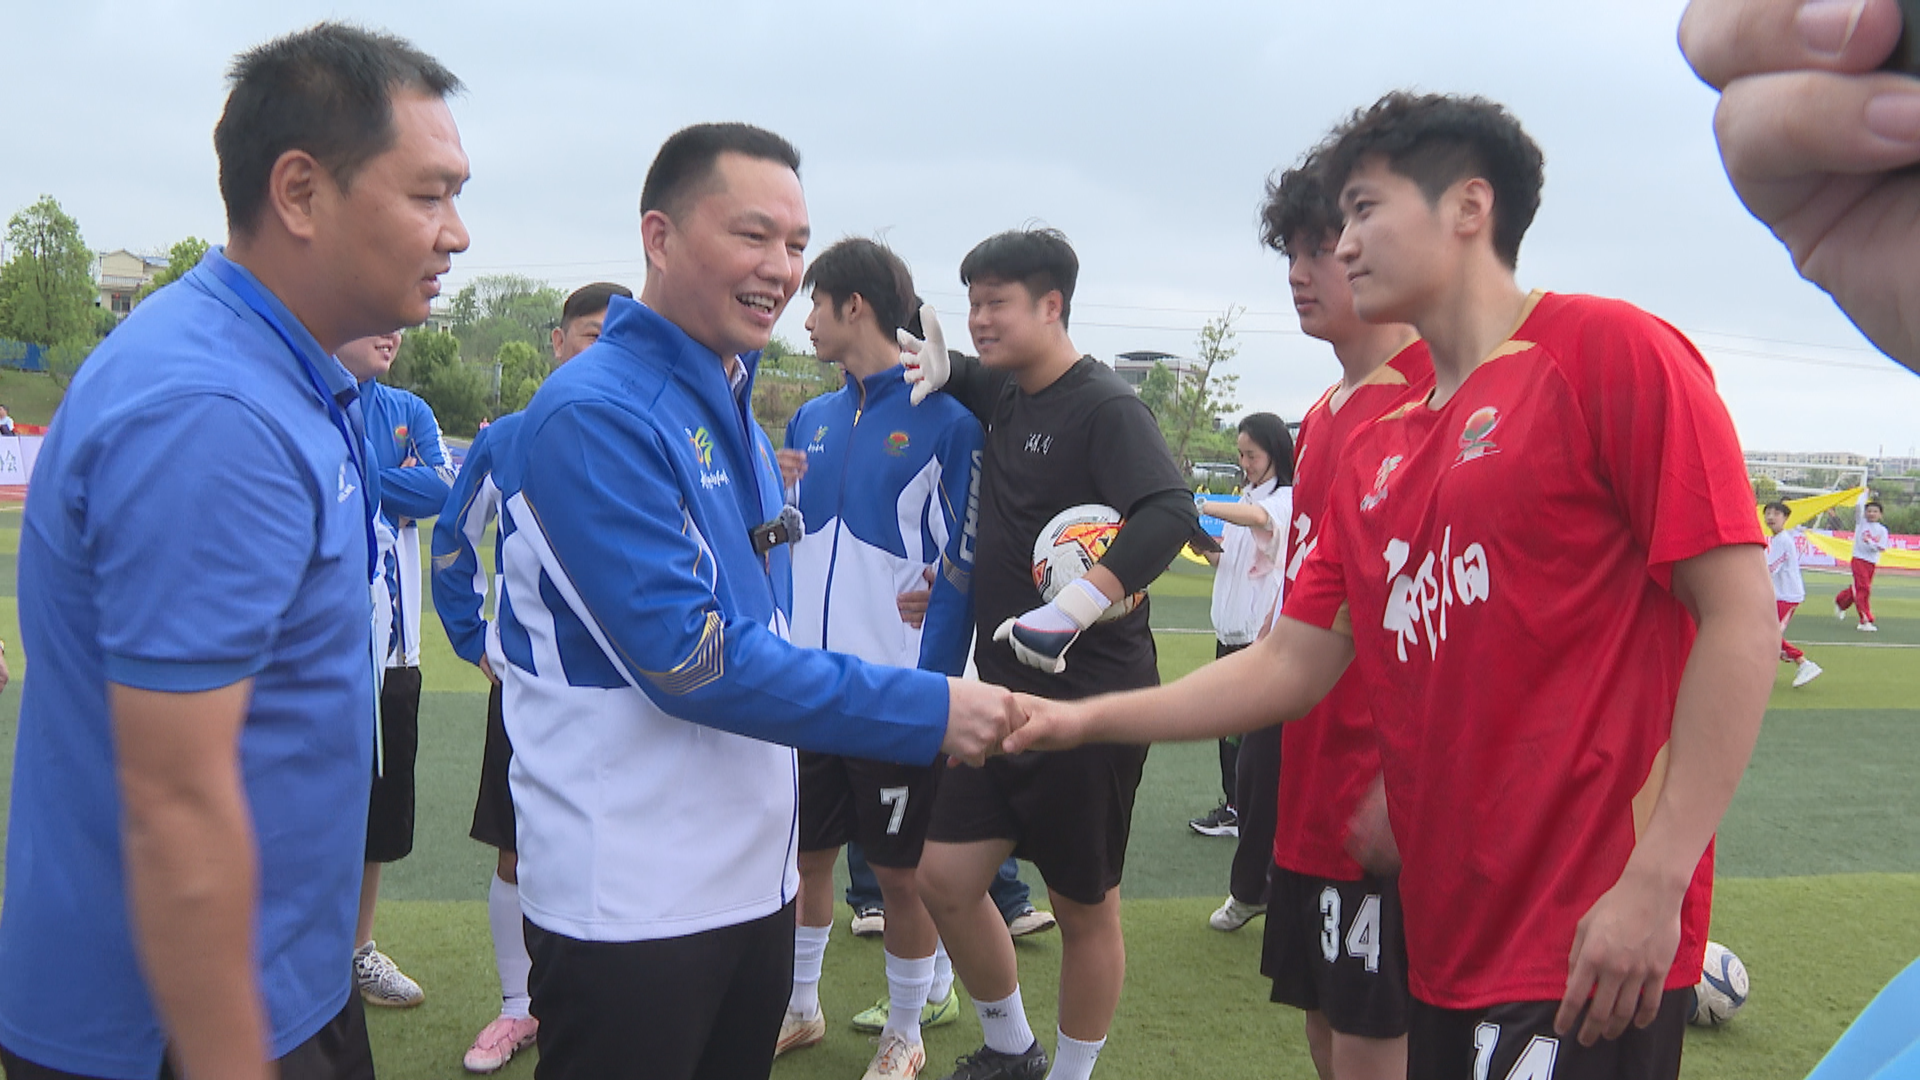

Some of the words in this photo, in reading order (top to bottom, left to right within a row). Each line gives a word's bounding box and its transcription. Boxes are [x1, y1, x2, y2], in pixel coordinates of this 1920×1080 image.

[959, 450, 984, 565] CHINA
[880, 786, 909, 835] 7
[1319, 886, 1381, 973] 34
